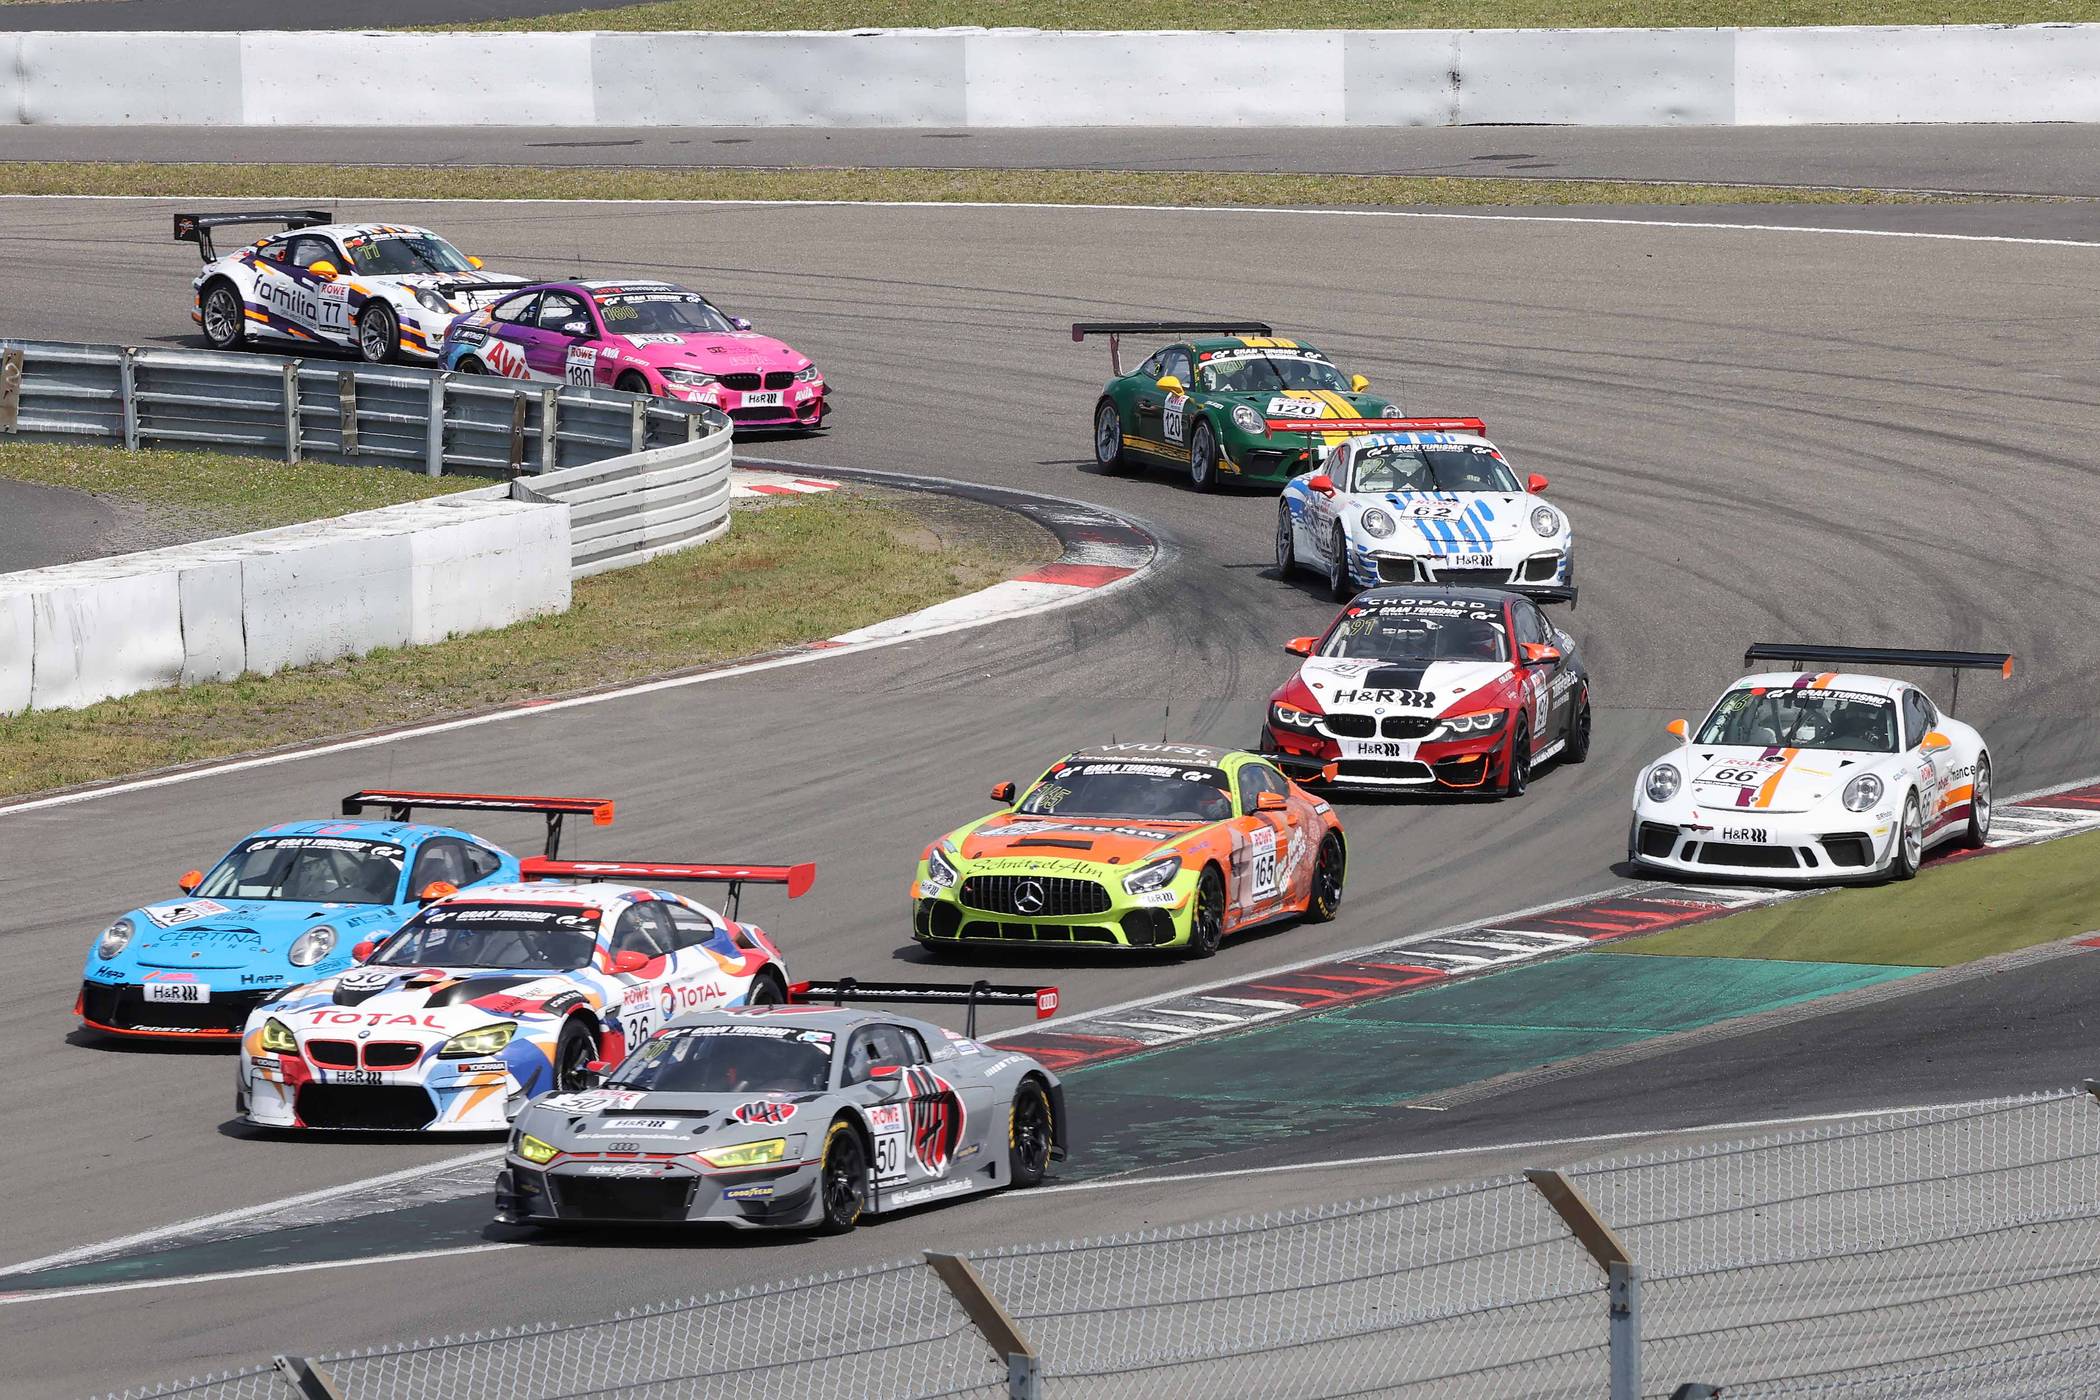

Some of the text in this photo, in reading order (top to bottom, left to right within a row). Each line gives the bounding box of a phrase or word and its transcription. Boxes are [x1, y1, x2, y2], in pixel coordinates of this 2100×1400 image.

[254, 273, 317, 321] familia
[321, 283, 345, 297] ROWE
[322, 301, 341, 323] 77
[603, 305, 639, 321] 180
[570, 347, 593, 360] ROWE
[601, 347, 620, 359] AVIA
[1233, 348, 1258, 356] GRAN
[568, 366, 591, 387] 180
[687, 391, 718, 404] AVIA
[795, 386, 814, 401] AVIA
[1276, 404, 1316, 415] 120
[1165, 411, 1181, 437] 120
[1391, 444, 1419, 452] GRAN
[1421, 443, 1464, 452] TURISMO
[1414, 506, 1452, 518] 62
[1367, 598, 1486, 609] CHOPARD
[1379, 606, 1413, 615] GRAN
[1414, 606, 1464, 616] TURISMO
[1334, 689, 1400, 704] H&R
[1720, 694, 1752, 712] 66
[1797, 689, 1832, 698] GRAN
[1832, 690, 1886, 705] TURISMO
[1099, 742, 1213, 758] Wurst
[1357, 743, 1383, 754] H&R
[1082, 763, 1118, 774] GRAN
[1119, 763, 1177, 775] TURISMO
[1726, 758, 1775, 769] ROWE
[1714, 768, 1758, 783] 66
[1070, 824, 1167, 840] REHM
[1253, 828, 1273, 847] ROWE
[1723, 827, 1750, 841] H&R
[275, 838, 311, 848] GRAN
[311, 839, 366, 850] TURISMO
[1254, 854, 1275, 889] 165
[456, 910, 494, 920] GRAN
[495, 910, 552, 922] TURISMO
[158, 931, 262, 946] CERTINA
[153, 986, 180, 999] H&R
[623, 986, 650, 1007] ROWE
[677, 981, 728, 1008] TOTAL
[308, 1009, 447, 1030] TOTAL
[628, 1015, 650, 1051] 36
[690, 1025, 729, 1036] GRAN
[729, 1025, 791, 1037] TURISMO
[468, 1062, 506, 1073] YOKOHAMA
[336, 1071, 364, 1084] H&R
[592, 1089, 638, 1101] ROWE
[871, 1106, 900, 1126] ROWE
[615, 1119, 647, 1128] H&R
[876, 1137, 897, 1174] 50
[727, 1187, 774, 1198] GOODYEAR
